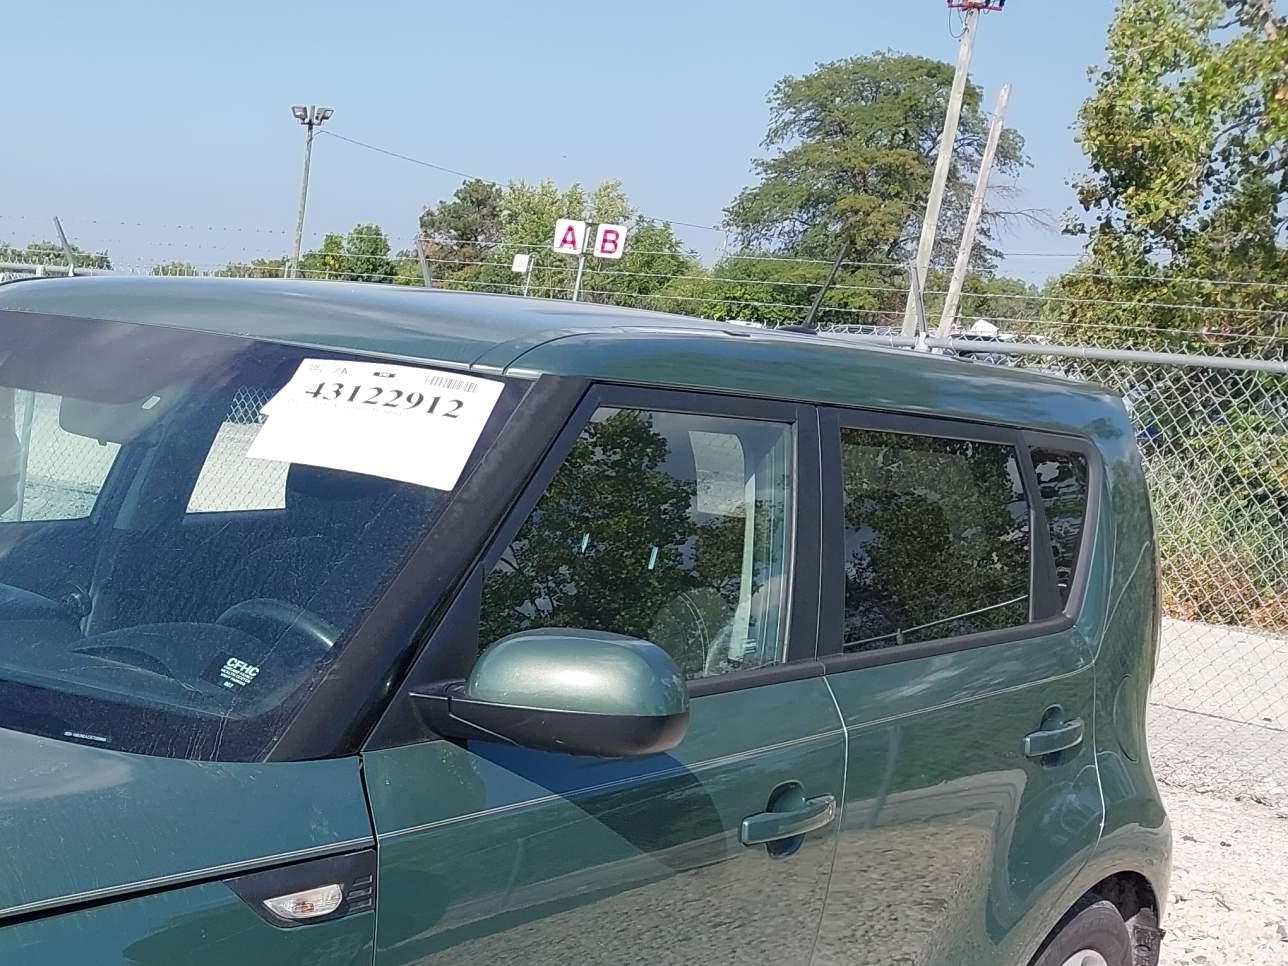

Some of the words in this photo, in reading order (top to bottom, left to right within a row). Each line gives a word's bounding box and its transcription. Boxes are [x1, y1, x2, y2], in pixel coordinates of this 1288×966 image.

[560, 225, 577, 250] A
[600, 229, 620, 254] B
[304, 381, 465, 419] 43122912
[226, 657, 260, 677] CFHC
